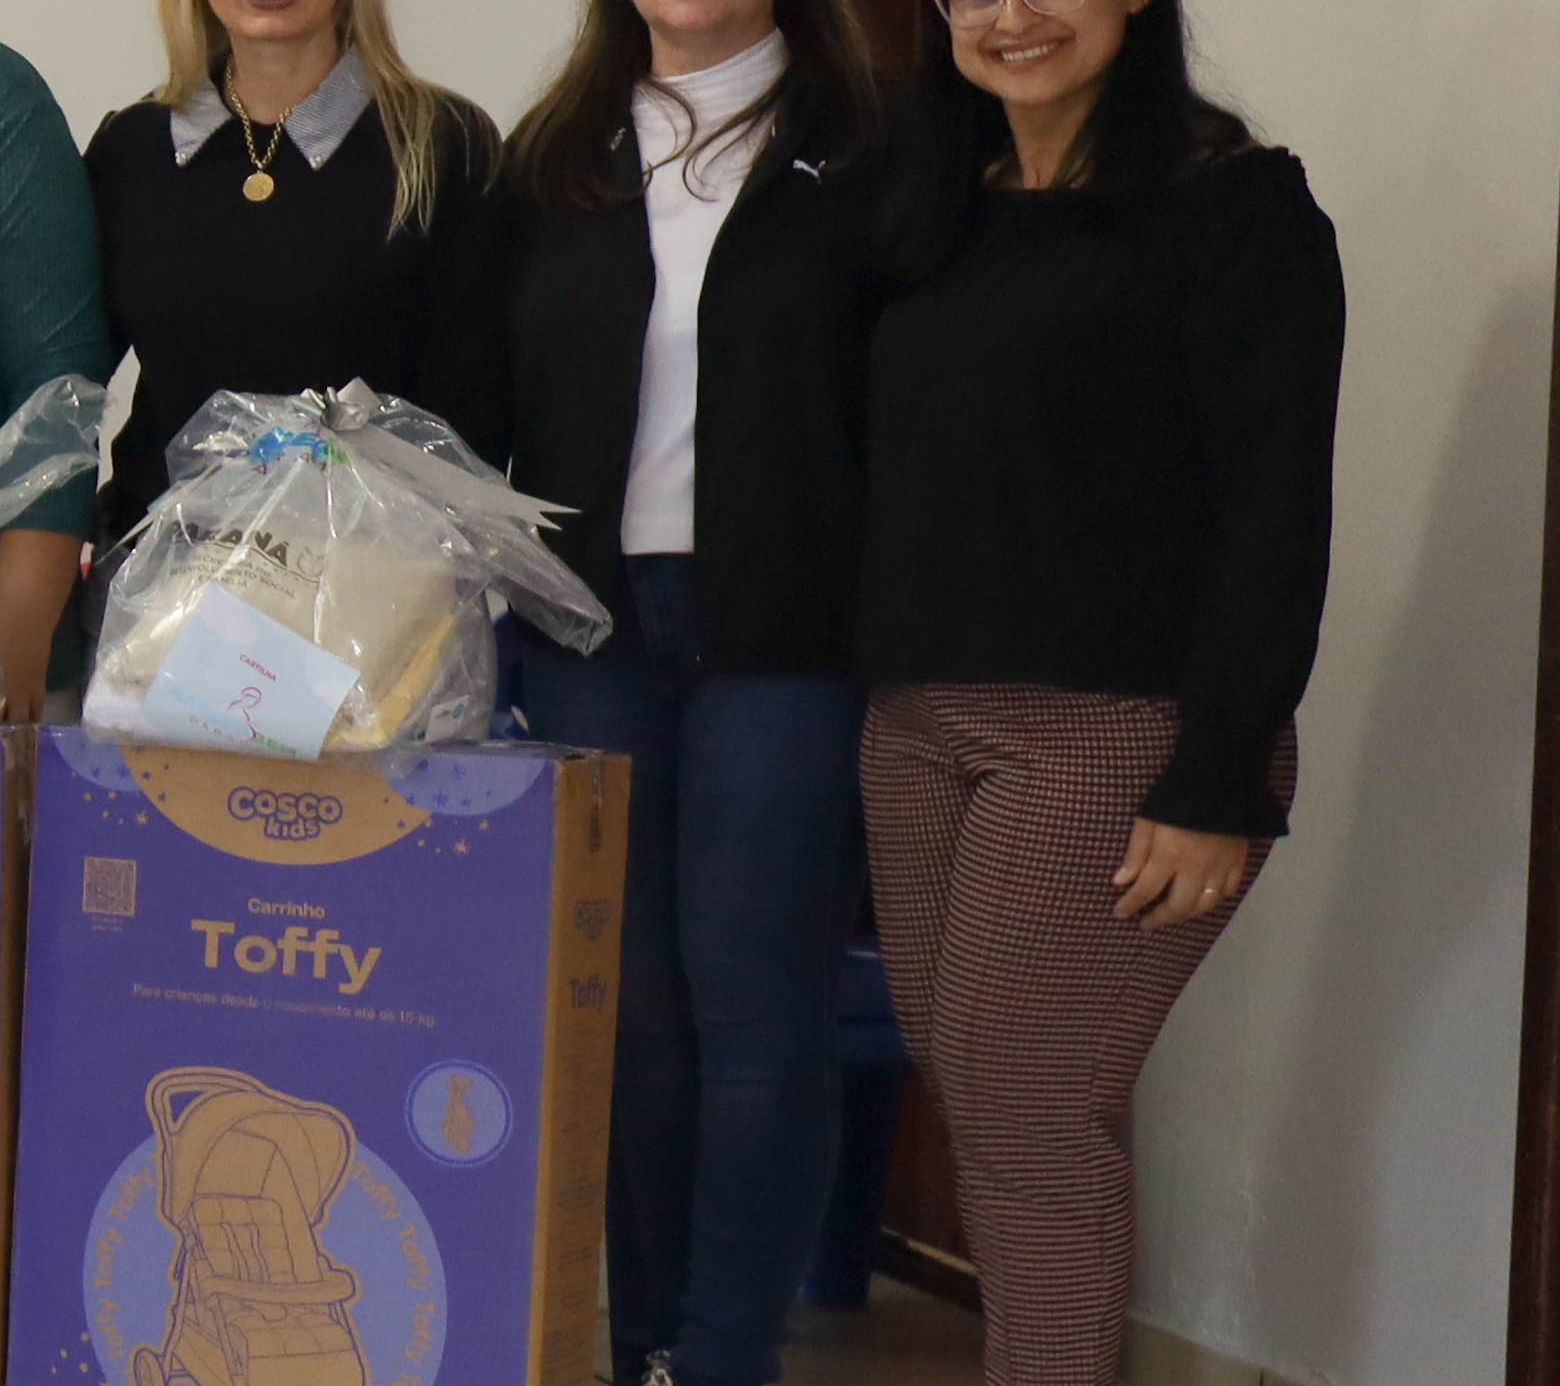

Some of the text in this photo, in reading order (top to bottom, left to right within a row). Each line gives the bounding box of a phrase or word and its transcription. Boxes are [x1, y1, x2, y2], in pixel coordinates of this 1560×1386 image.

[264, 814, 319, 842] kids
[248, 898, 325, 919] Carrinho
[191, 919, 382, 996] Toffy
[132, 983, 160, 997] Para
[164, 987, 217, 1005] crianças
